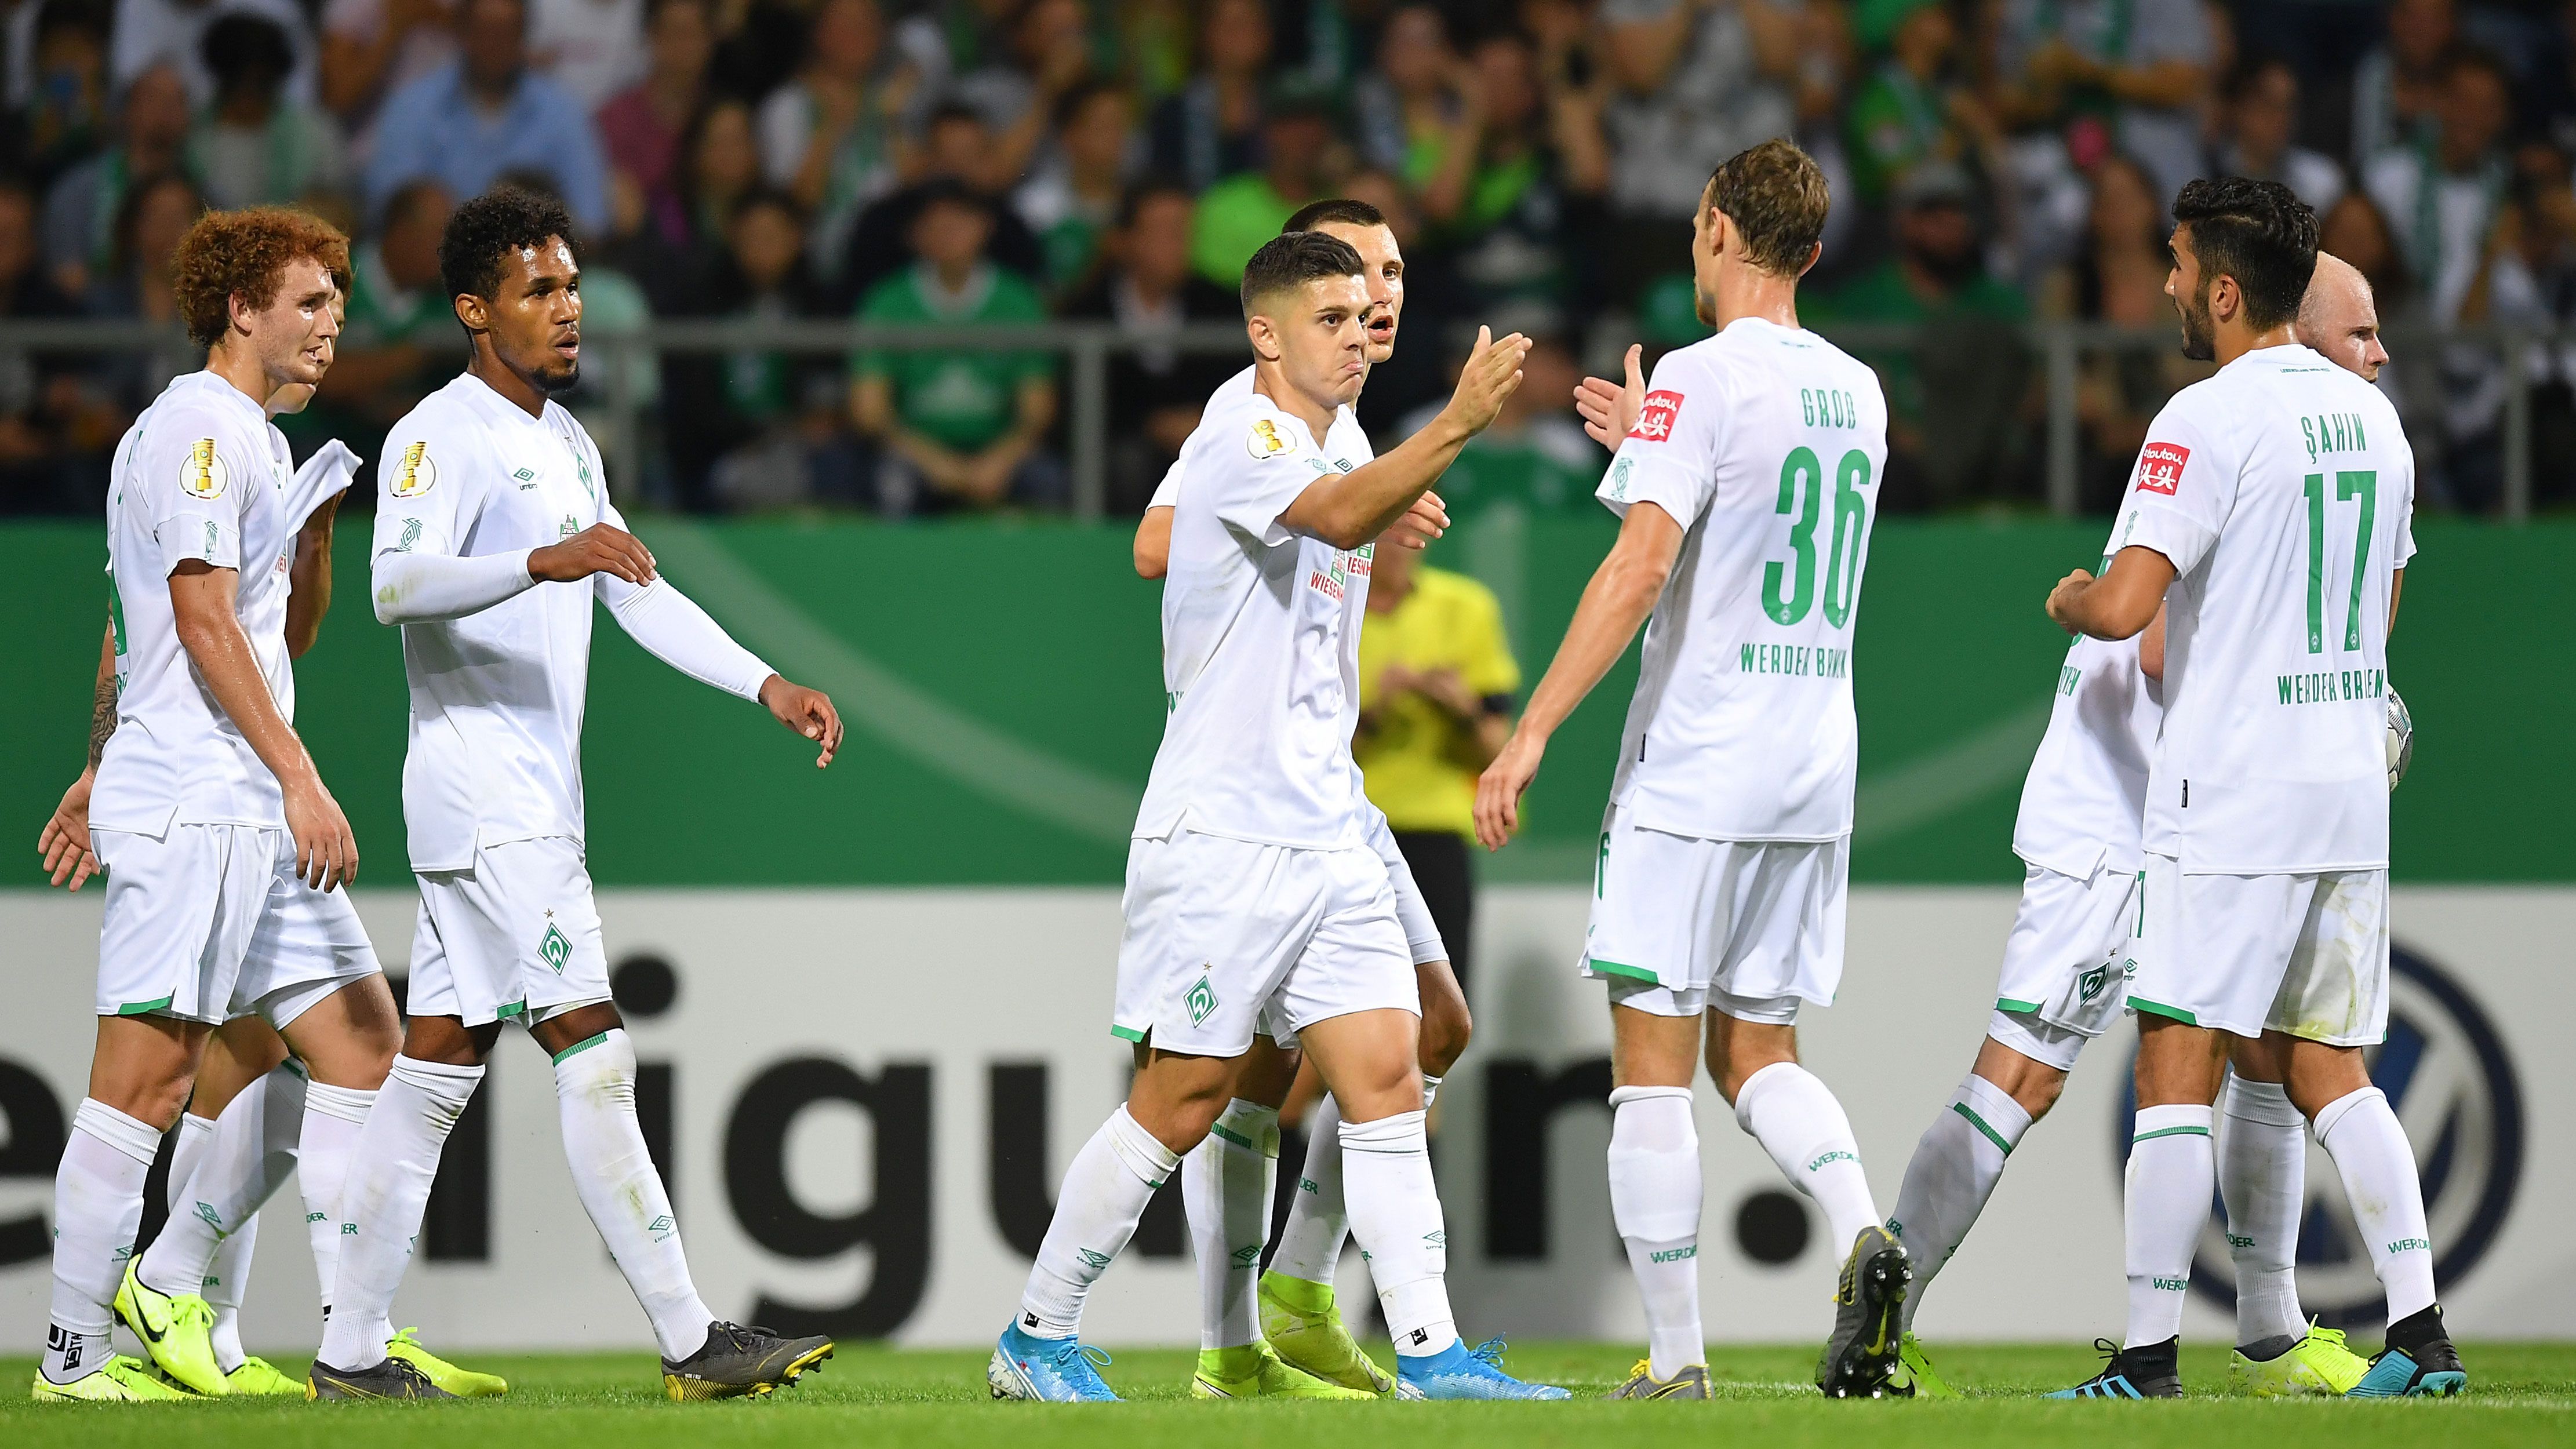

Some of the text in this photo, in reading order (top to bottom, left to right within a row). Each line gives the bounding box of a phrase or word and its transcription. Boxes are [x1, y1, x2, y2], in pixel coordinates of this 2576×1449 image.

[2301, 413, 2366, 464] ŞAHIN
[1761, 446, 1871, 630] 36
[2304, 471, 2377, 654] 17
[2277, 673, 2337, 705] WERDER
